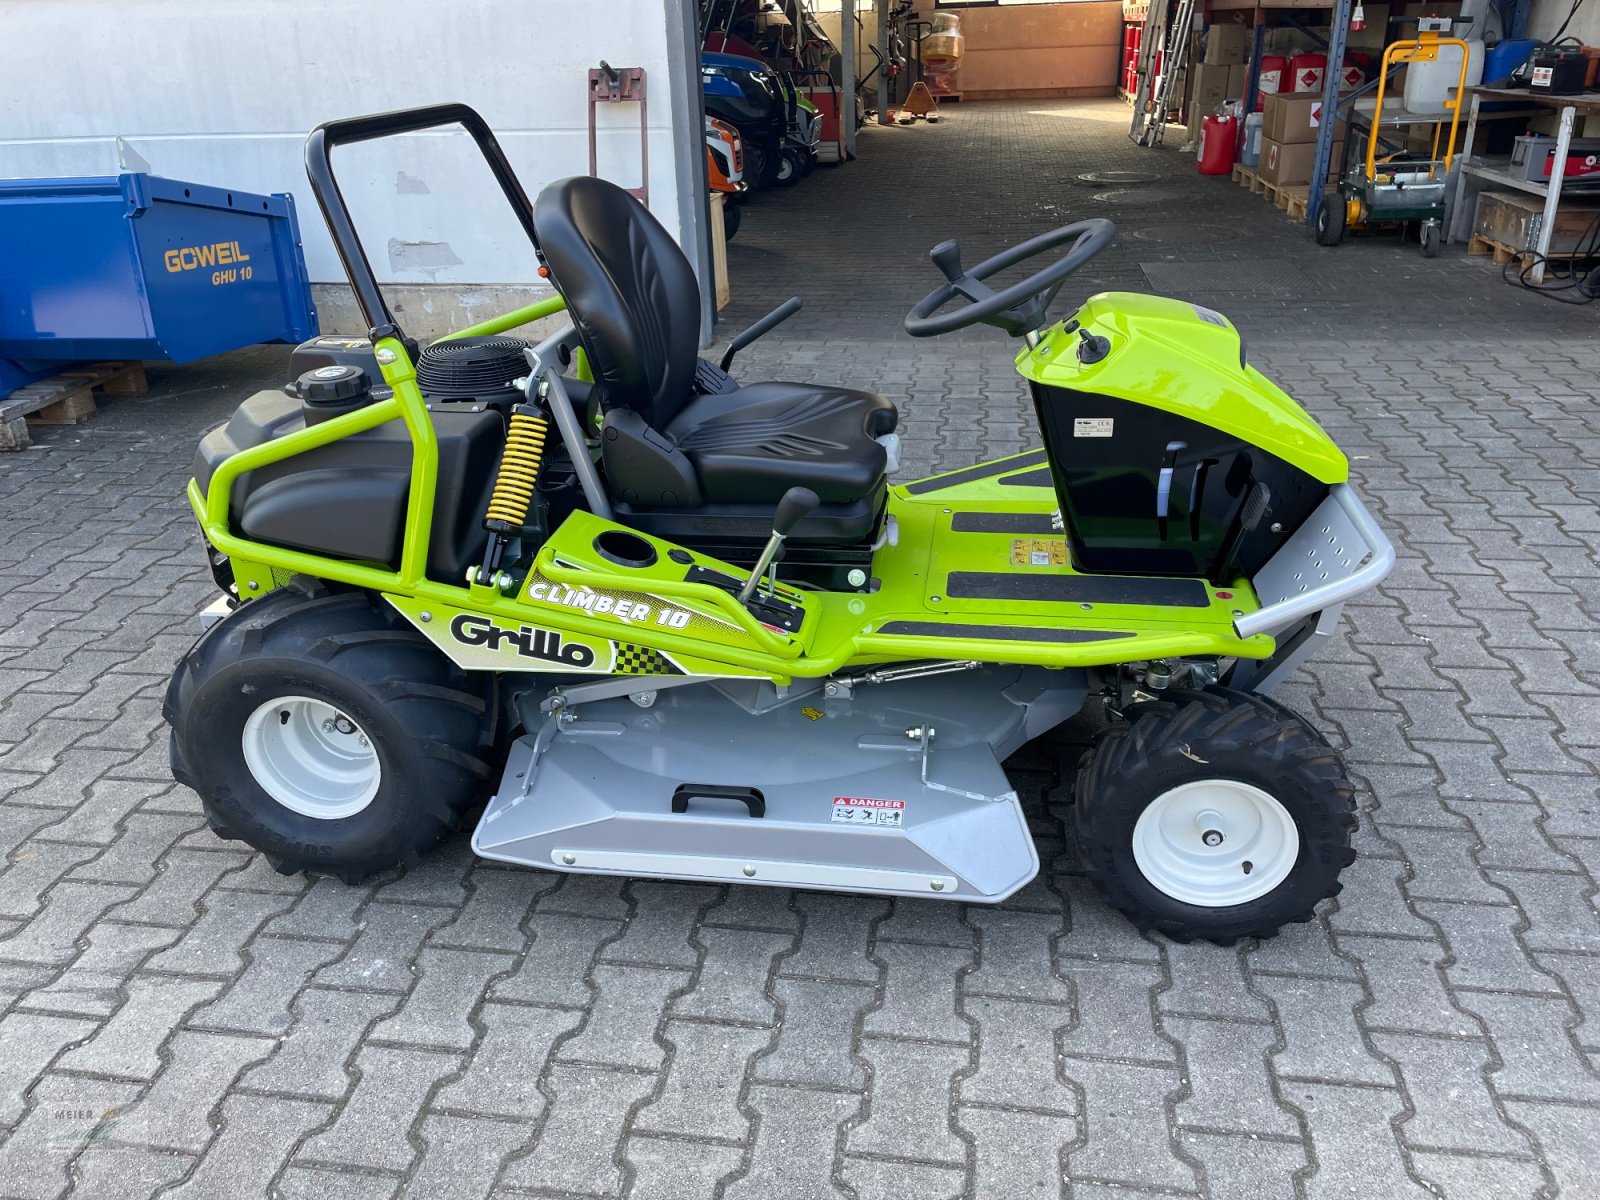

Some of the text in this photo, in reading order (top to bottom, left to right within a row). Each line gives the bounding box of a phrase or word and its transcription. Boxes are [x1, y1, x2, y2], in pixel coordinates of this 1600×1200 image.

[211, 266, 253, 286] GHU 10
[528, 582, 692, 630] CLIMBER 10
[450, 613, 596, 669] Grillo
[849, 798, 902, 808] DANGER
